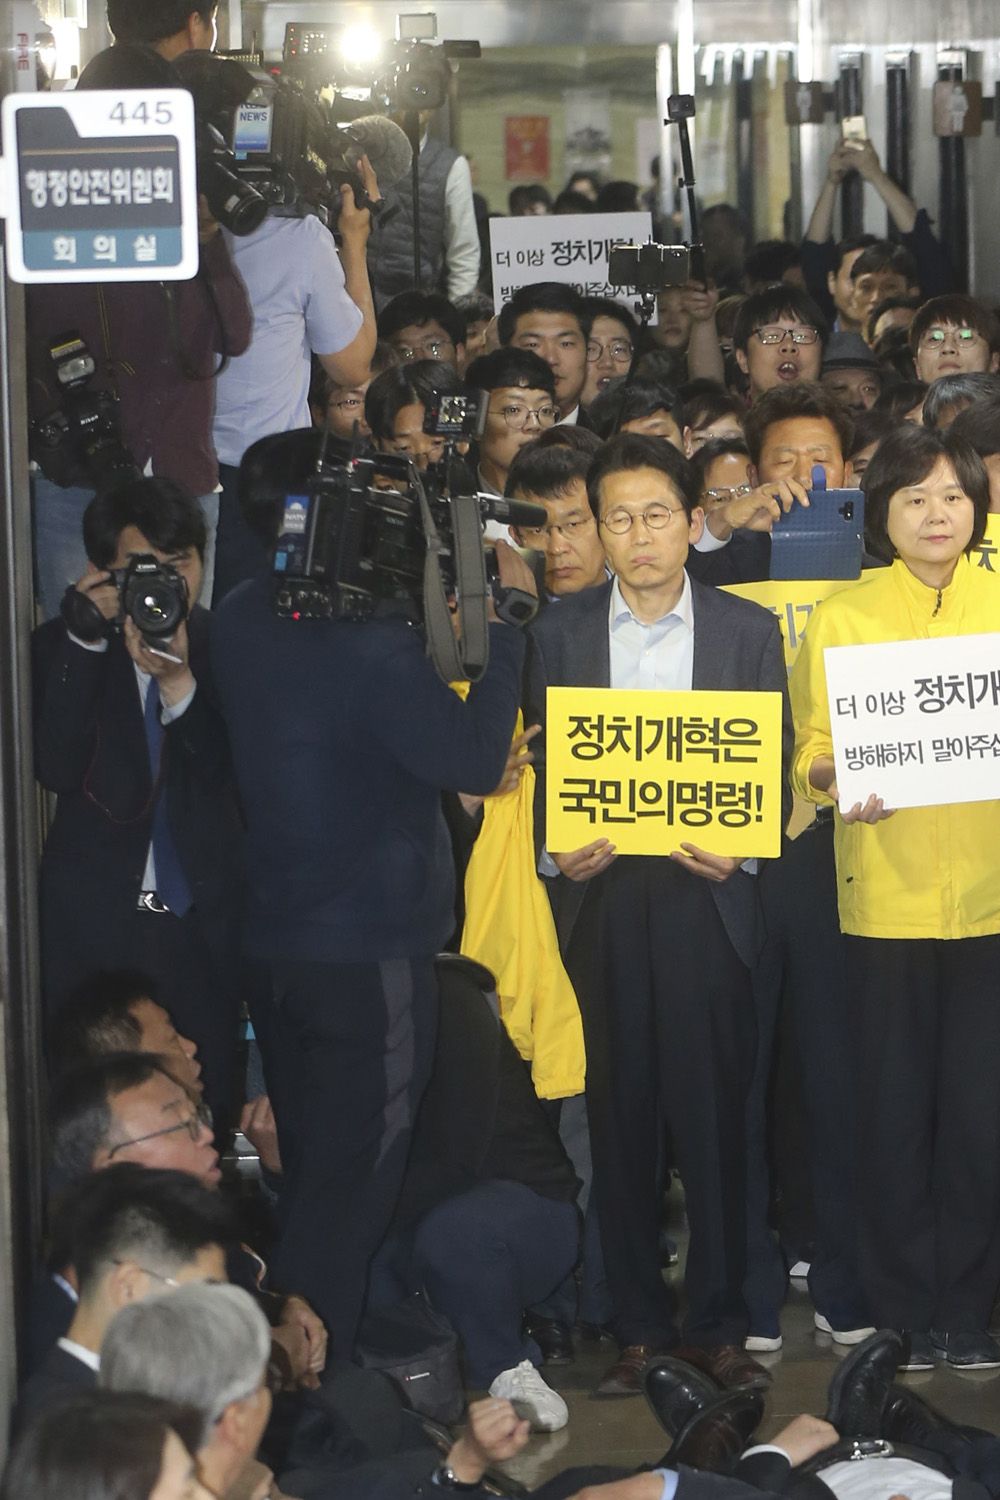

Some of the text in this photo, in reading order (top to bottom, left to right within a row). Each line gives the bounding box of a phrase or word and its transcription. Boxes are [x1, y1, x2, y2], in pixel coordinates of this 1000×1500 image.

[17, 33, 29, 71] FIRE
[109, 101, 173, 125] 445
[240, 112, 267, 121] NEWS
[25, 166, 174, 208] 행정안전위원회
[496, 251, 511, 267] 더
[516, 249, 544, 266] 이상
[836, 695, 858, 719] 더
[866, 690, 906, 716] 이상
[567, 714, 762, 763] 정치개혁은
[845, 740, 924, 771] 방해하지
[559, 778, 764, 828] 국민의명령!
